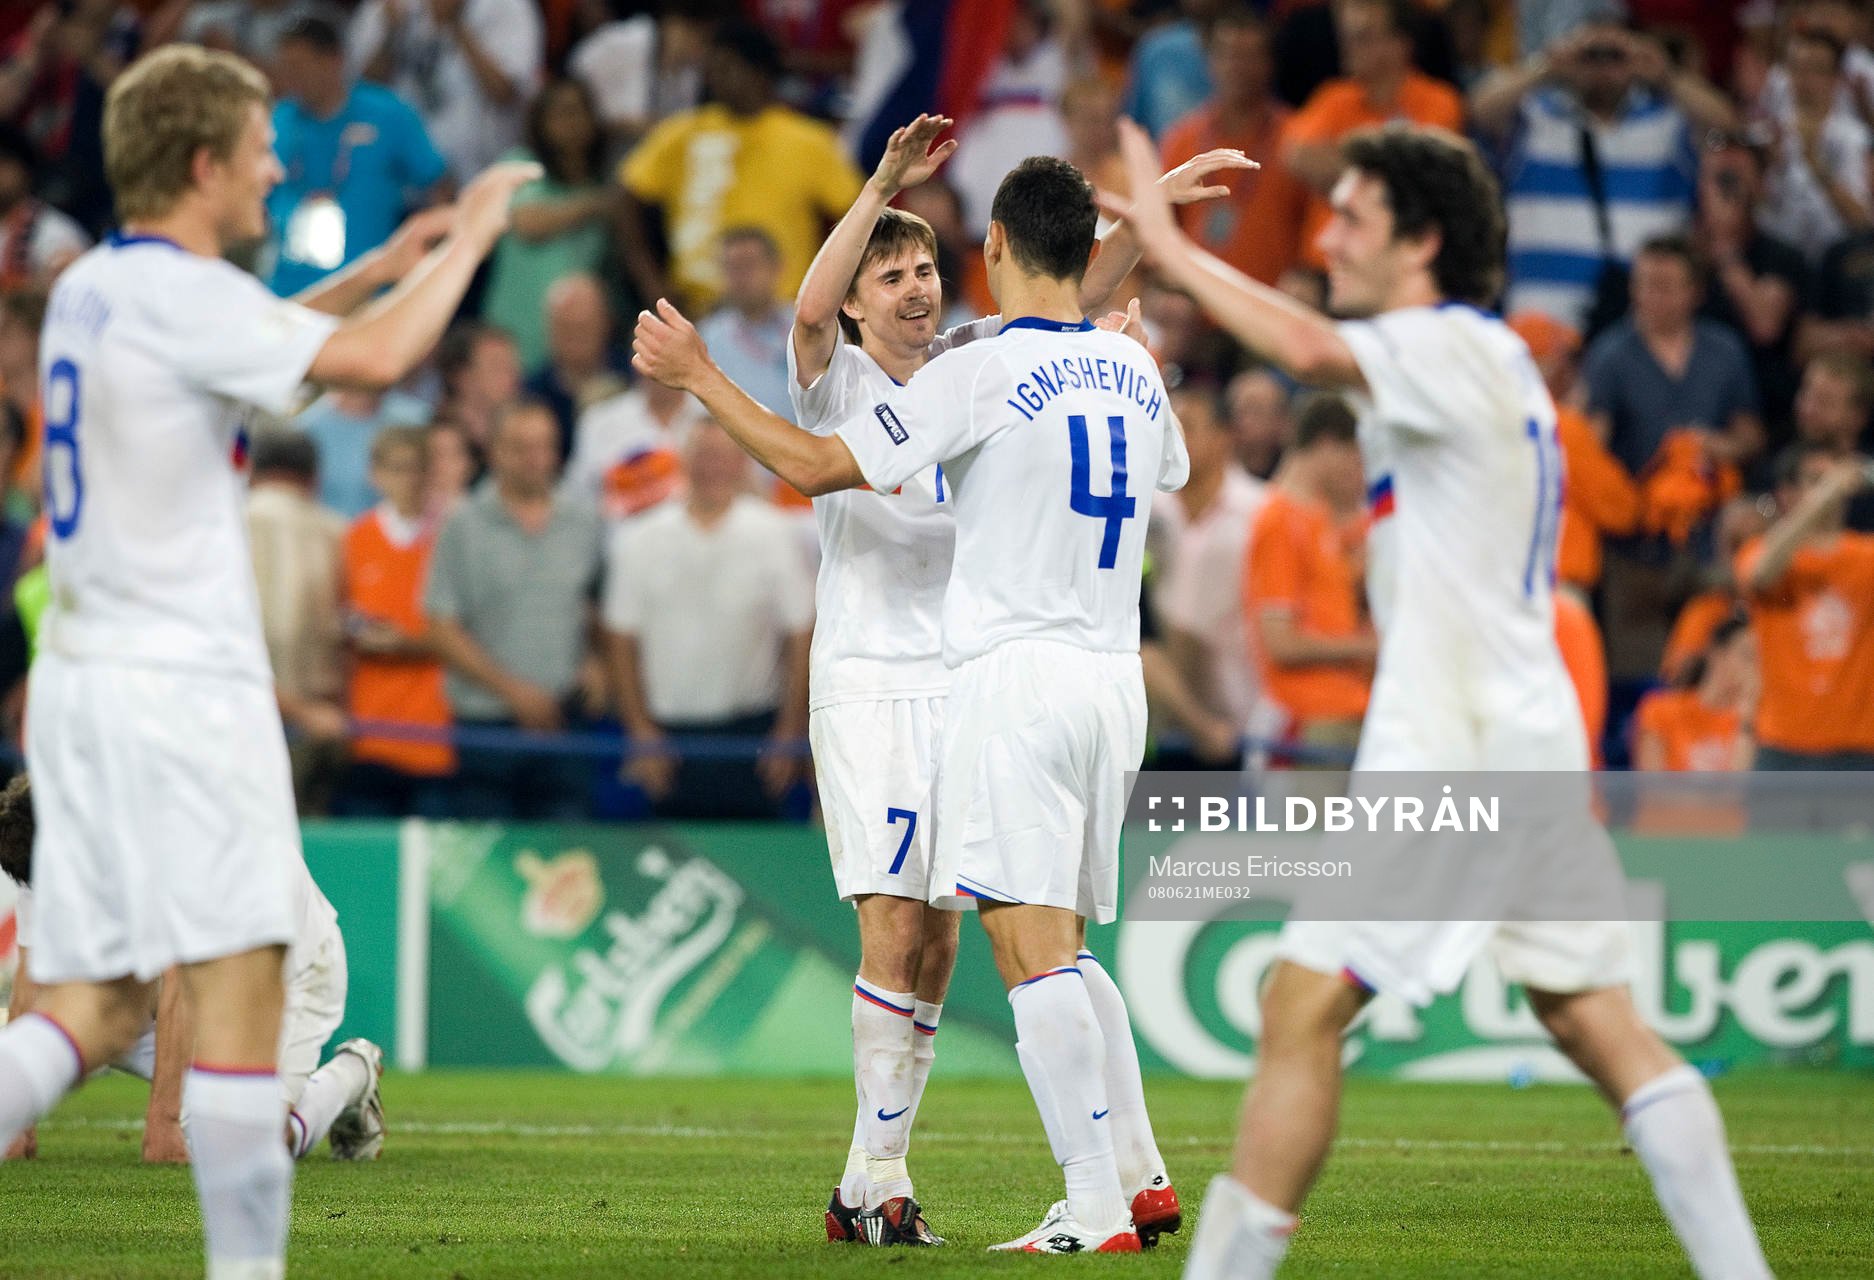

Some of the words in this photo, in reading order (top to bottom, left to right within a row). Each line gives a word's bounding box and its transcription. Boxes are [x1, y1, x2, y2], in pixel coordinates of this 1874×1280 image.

[1007, 357, 1161, 422] IGNASHEVICH
[46, 358, 83, 538] 8
[881, 409, 906, 441] RESPECT
[1067, 415, 1136, 569] 4
[887, 807, 917, 875] 7
